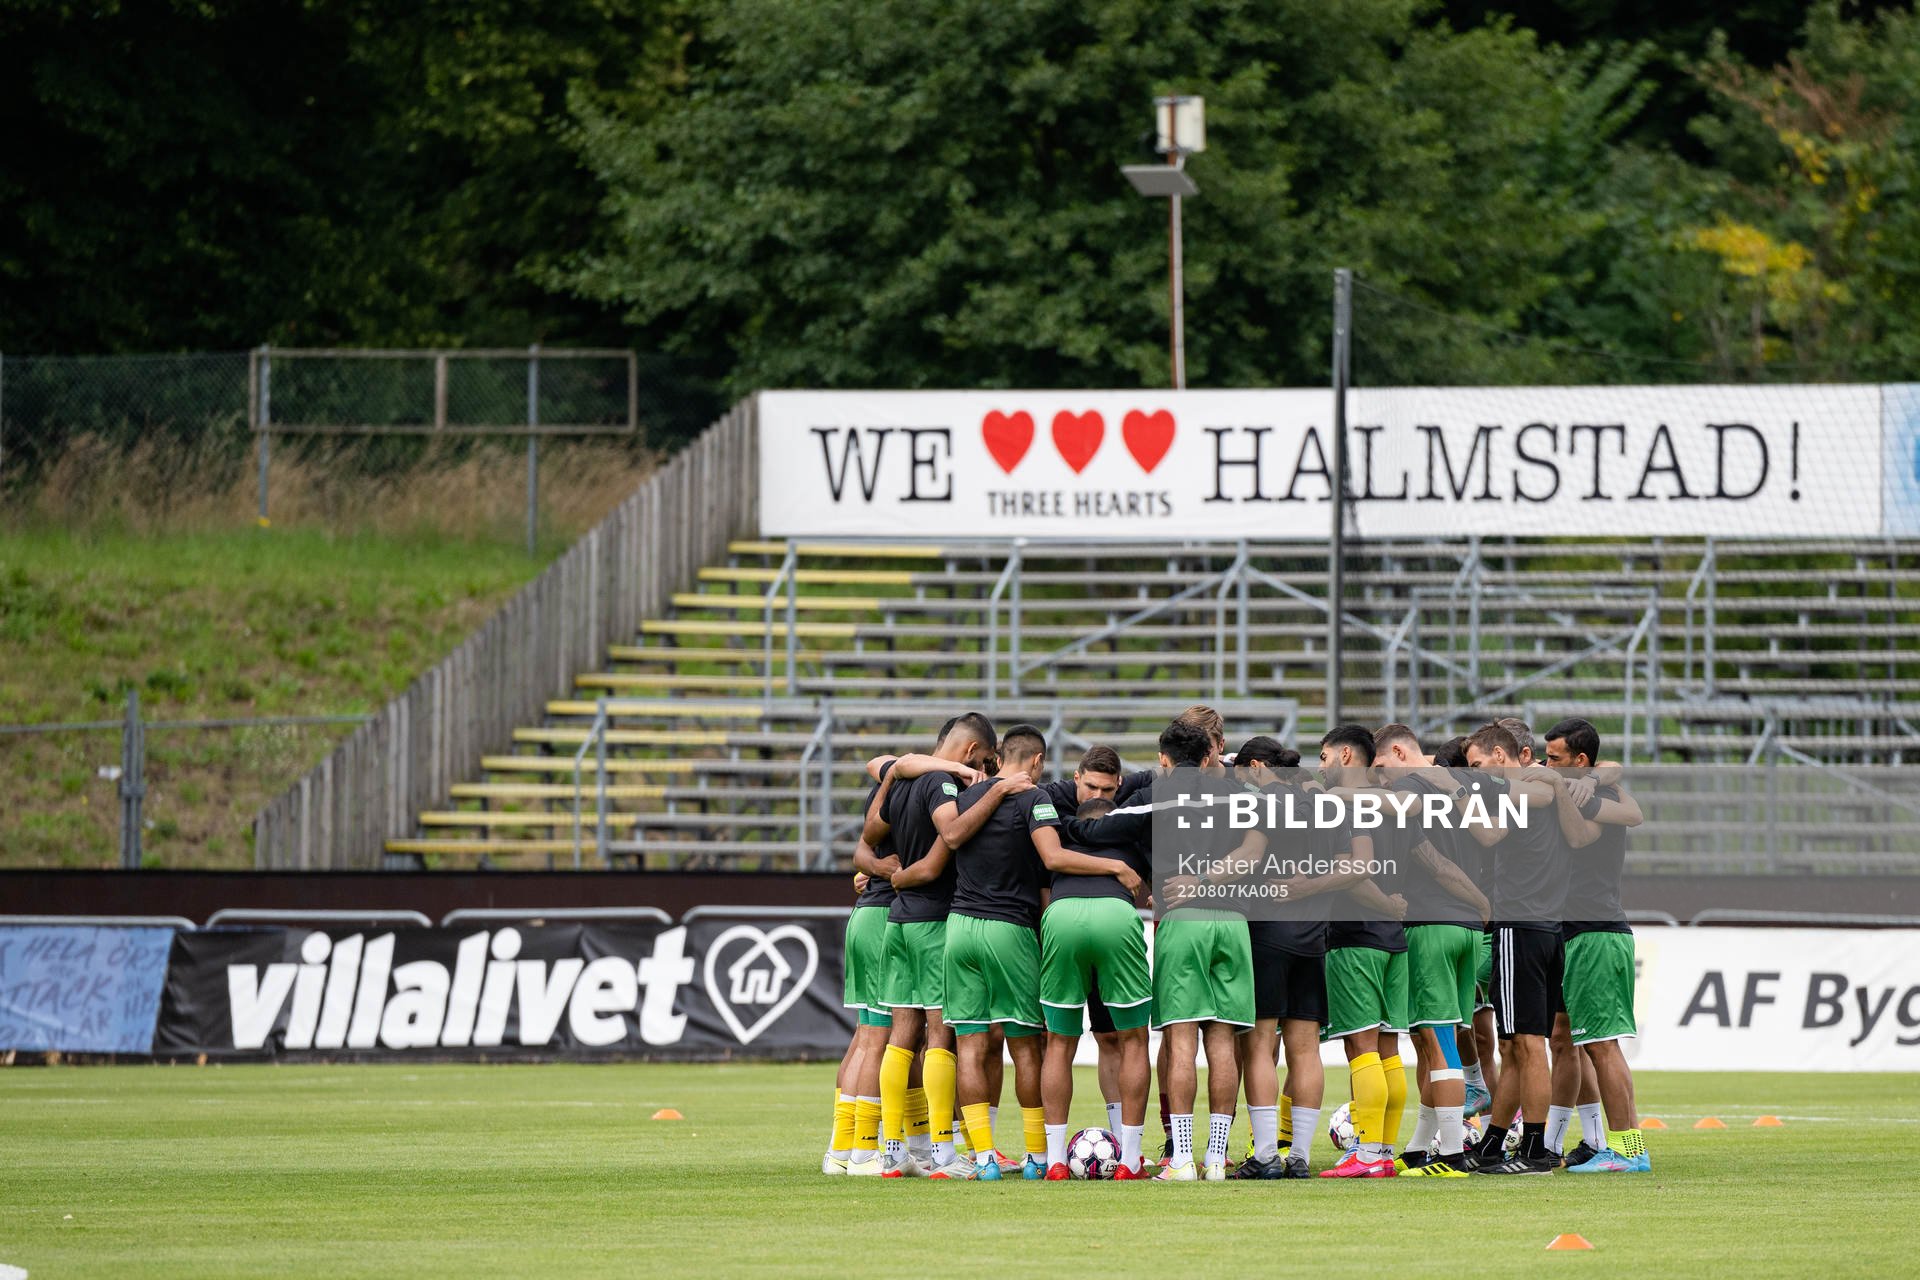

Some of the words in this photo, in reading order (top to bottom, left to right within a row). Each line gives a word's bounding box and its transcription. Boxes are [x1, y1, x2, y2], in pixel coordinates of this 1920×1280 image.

[810, 427, 953, 502] WE
[1203, 421, 1801, 503] HALMSTAD!
[988, 492, 1062, 516] THREE
[1075, 492, 1172, 516] HEARTS
[227, 925, 695, 1050] villalivet
[1677, 970, 1781, 1028] AF
